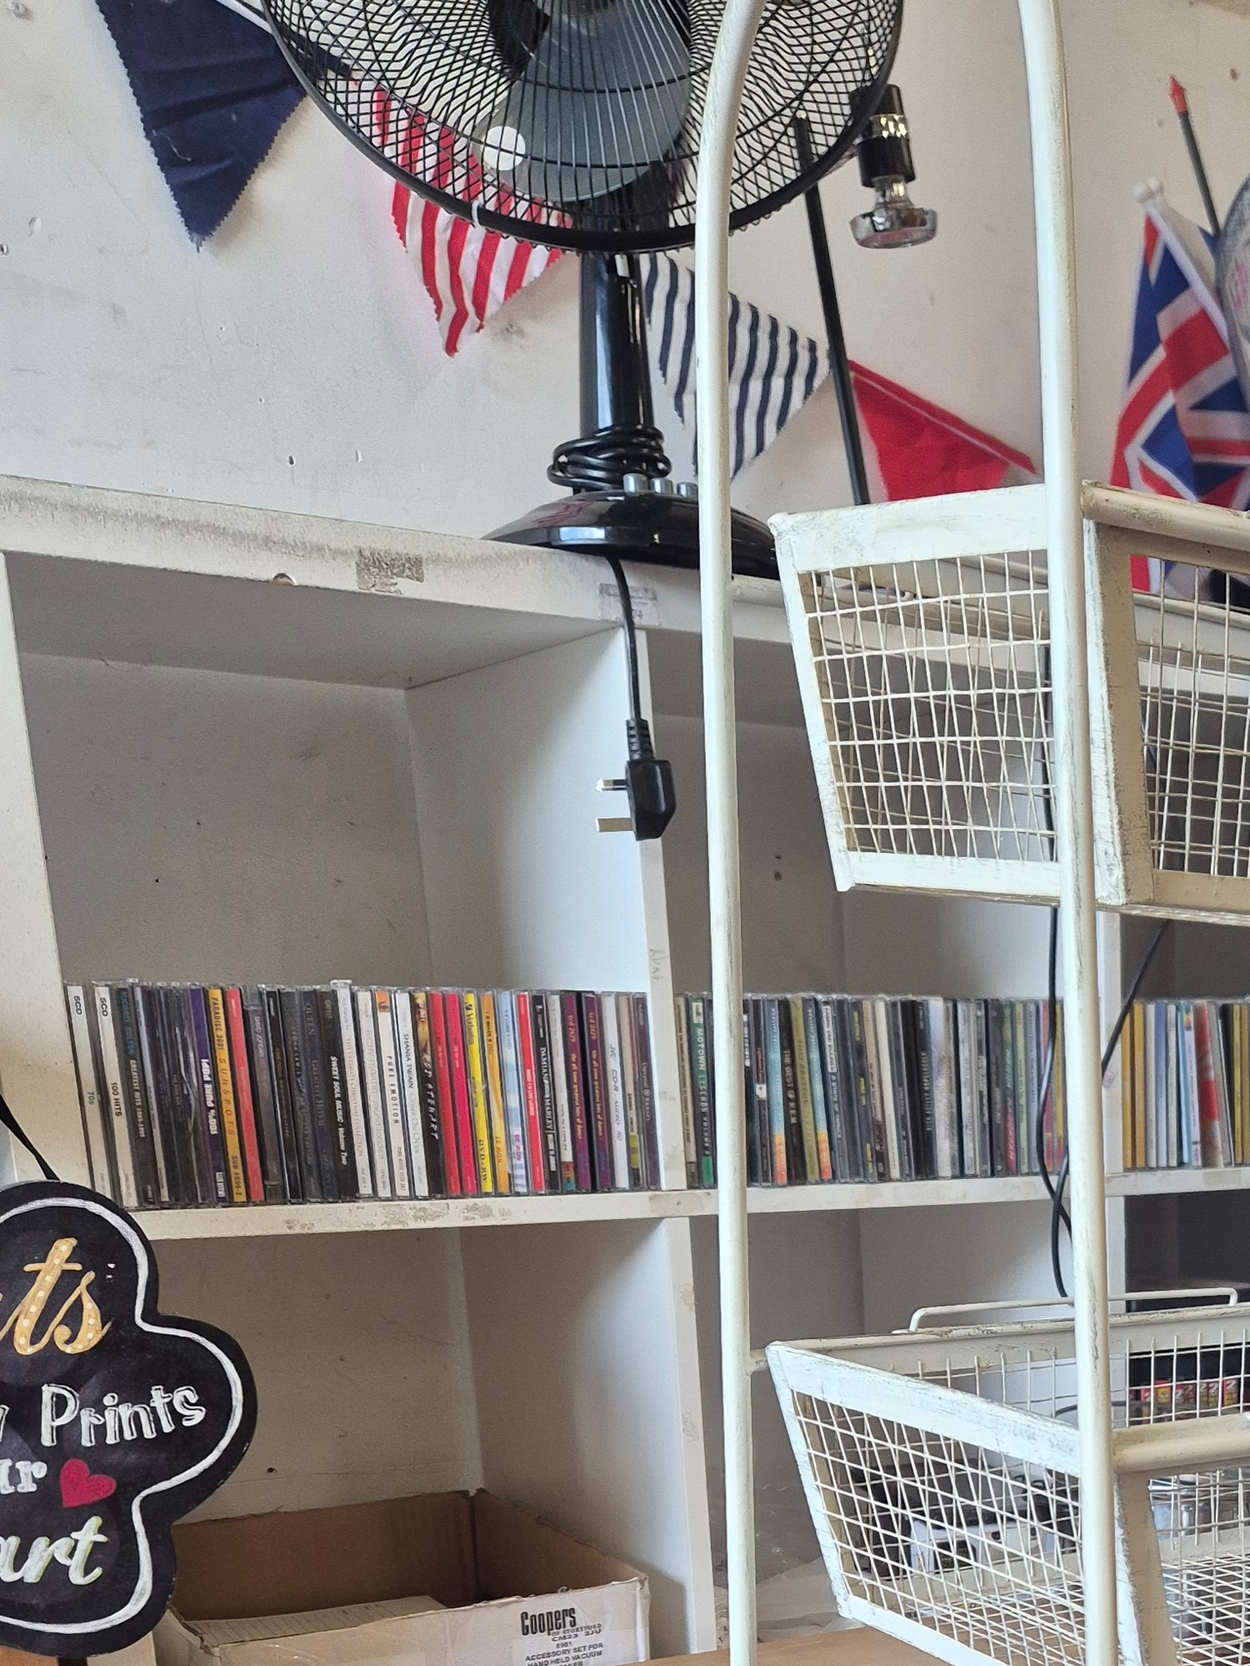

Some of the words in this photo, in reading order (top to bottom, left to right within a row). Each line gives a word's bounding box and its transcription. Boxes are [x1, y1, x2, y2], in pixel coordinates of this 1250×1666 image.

[74, 995, 82, 1015] 5CD
[100, 997, 108, 1017] 5CD
[212, 998, 223, 1031] PARADISE
[254, 1016, 263, 1033] DAVID
[305, 1003, 316, 1035] QUEEN
[256, 1034, 265, 1058] JORDAN
[403, 1034, 413, 1061] SHANIA
[696, 1028, 706, 1070] MOTOWN
[783, 1050, 792, 1065] THE
[130, 1059, 139, 1090] GREATEST
[330, 1056, 340, 1080] SWEET
[387, 1055, 396, 1078] PURE
[405, 1062, 414, 1089] TWAIN
[785, 1066, 793, 1088] BEST
[111, 1082, 119, 1096] 100
[133, 1091, 142, 1106] HITS
[204, 1083, 214, 1107] PURE
[332, 1081, 341, 1099] SOUL
[345, 1038, 353, 1050] THE
[353, 1119, 364, 1157] COLLECTION
[540, 1047, 549, 1080] DAMIAN
[545, 1098, 553, 1130] MARLEY
[697, 1073, 708, 1112] LEGENDS
[787, 1090, 795, 1100] OF
[113, 1098, 122, 1117] HITS
[335, 1100, 344, 1123] MUSIC
[389, 1083, 400, 1125] EMOTION
[0, 1237, 113, 1355] ts
[41, 1381, 207, 1448] Prints
[520, 1607, 576, 1636] Coopers
[525, 1649, 571, 1662] ACCESSORY
[572, 1645, 587, 1654] SET
[588, 1642, 604, 1650] FOR
[550, 1656, 570, 1665] HELD
[571, 1650, 603, 1661] VACUUM
